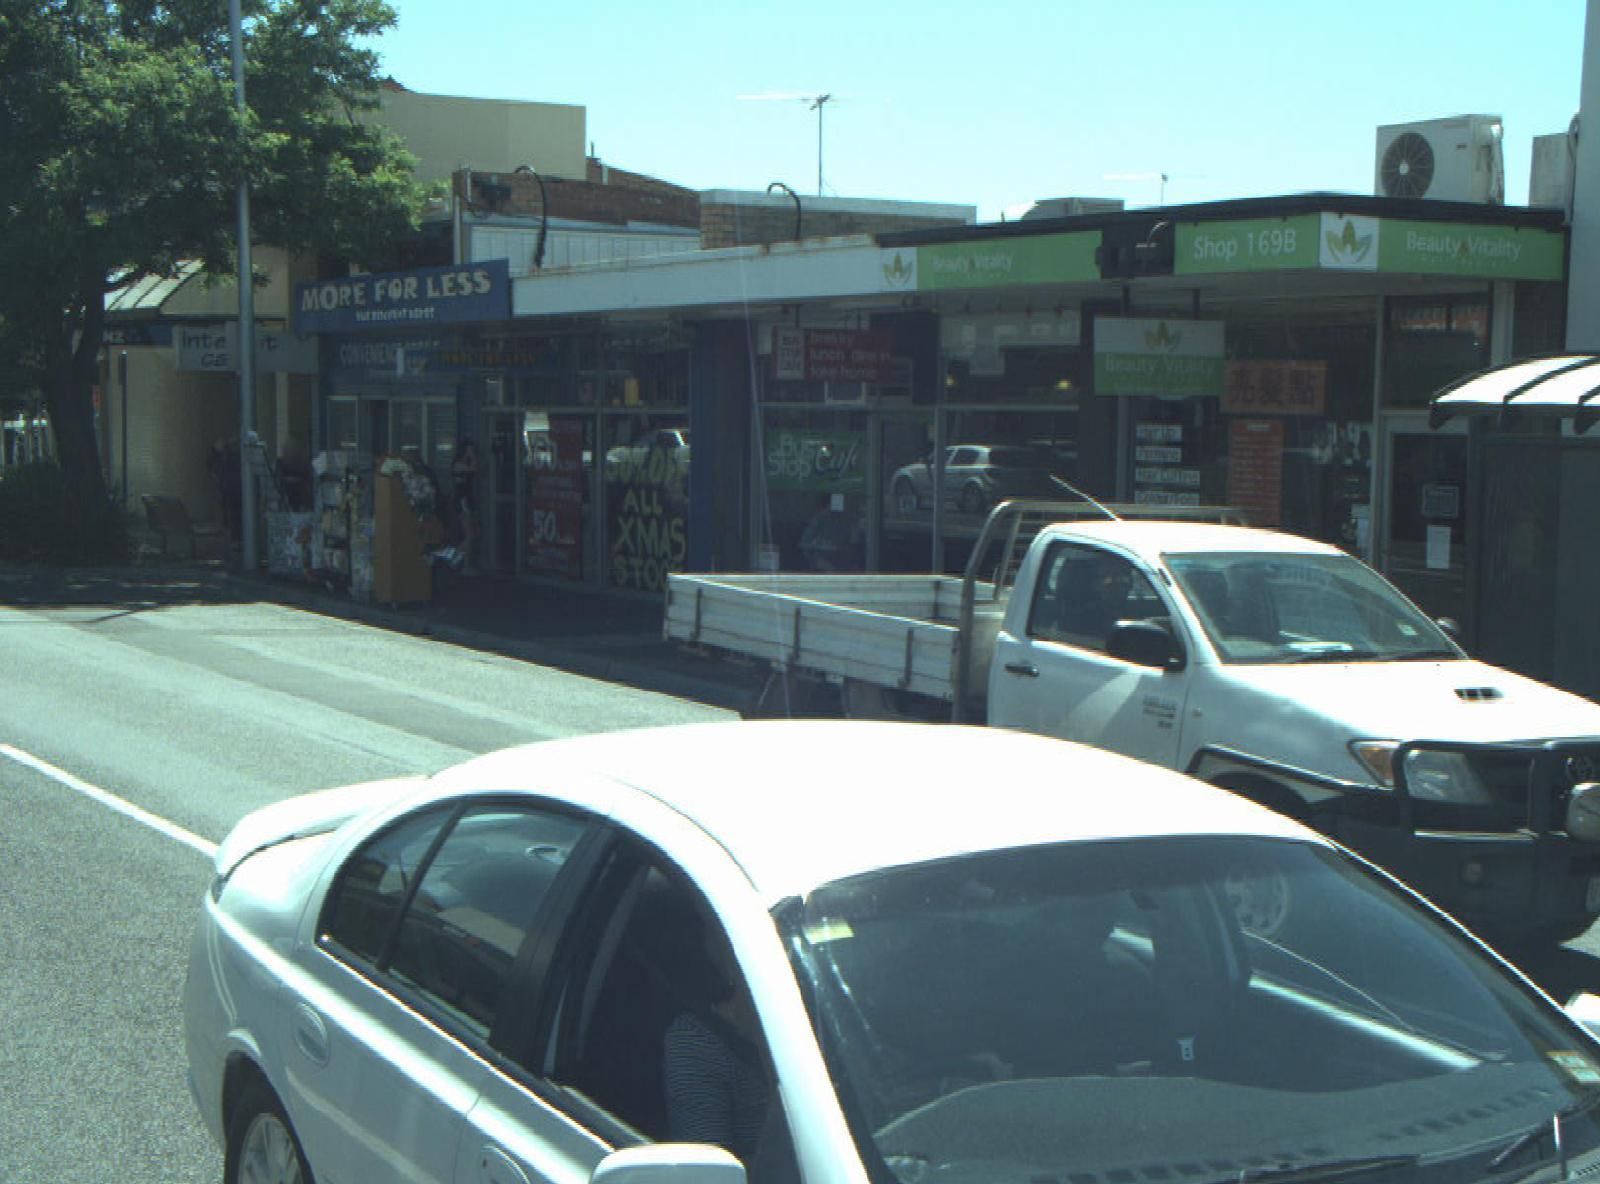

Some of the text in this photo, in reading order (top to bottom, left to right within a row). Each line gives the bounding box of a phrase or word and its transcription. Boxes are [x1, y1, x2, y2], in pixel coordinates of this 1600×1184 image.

[1193, 227, 1297, 262] Shop 169B
[1406, 229, 1523, 262] Beauty Vitality
[932, 251, 1015, 273] Beauty Vitality
[302, 271, 492, 312] MORE FOR LESS
[181, 329, 279, 352] Intet
[1105, 352, 1217, 379] Beauty Vitality
[622, 488, 664, 516] ALL
[613, 515, 687, 562] XMAS
